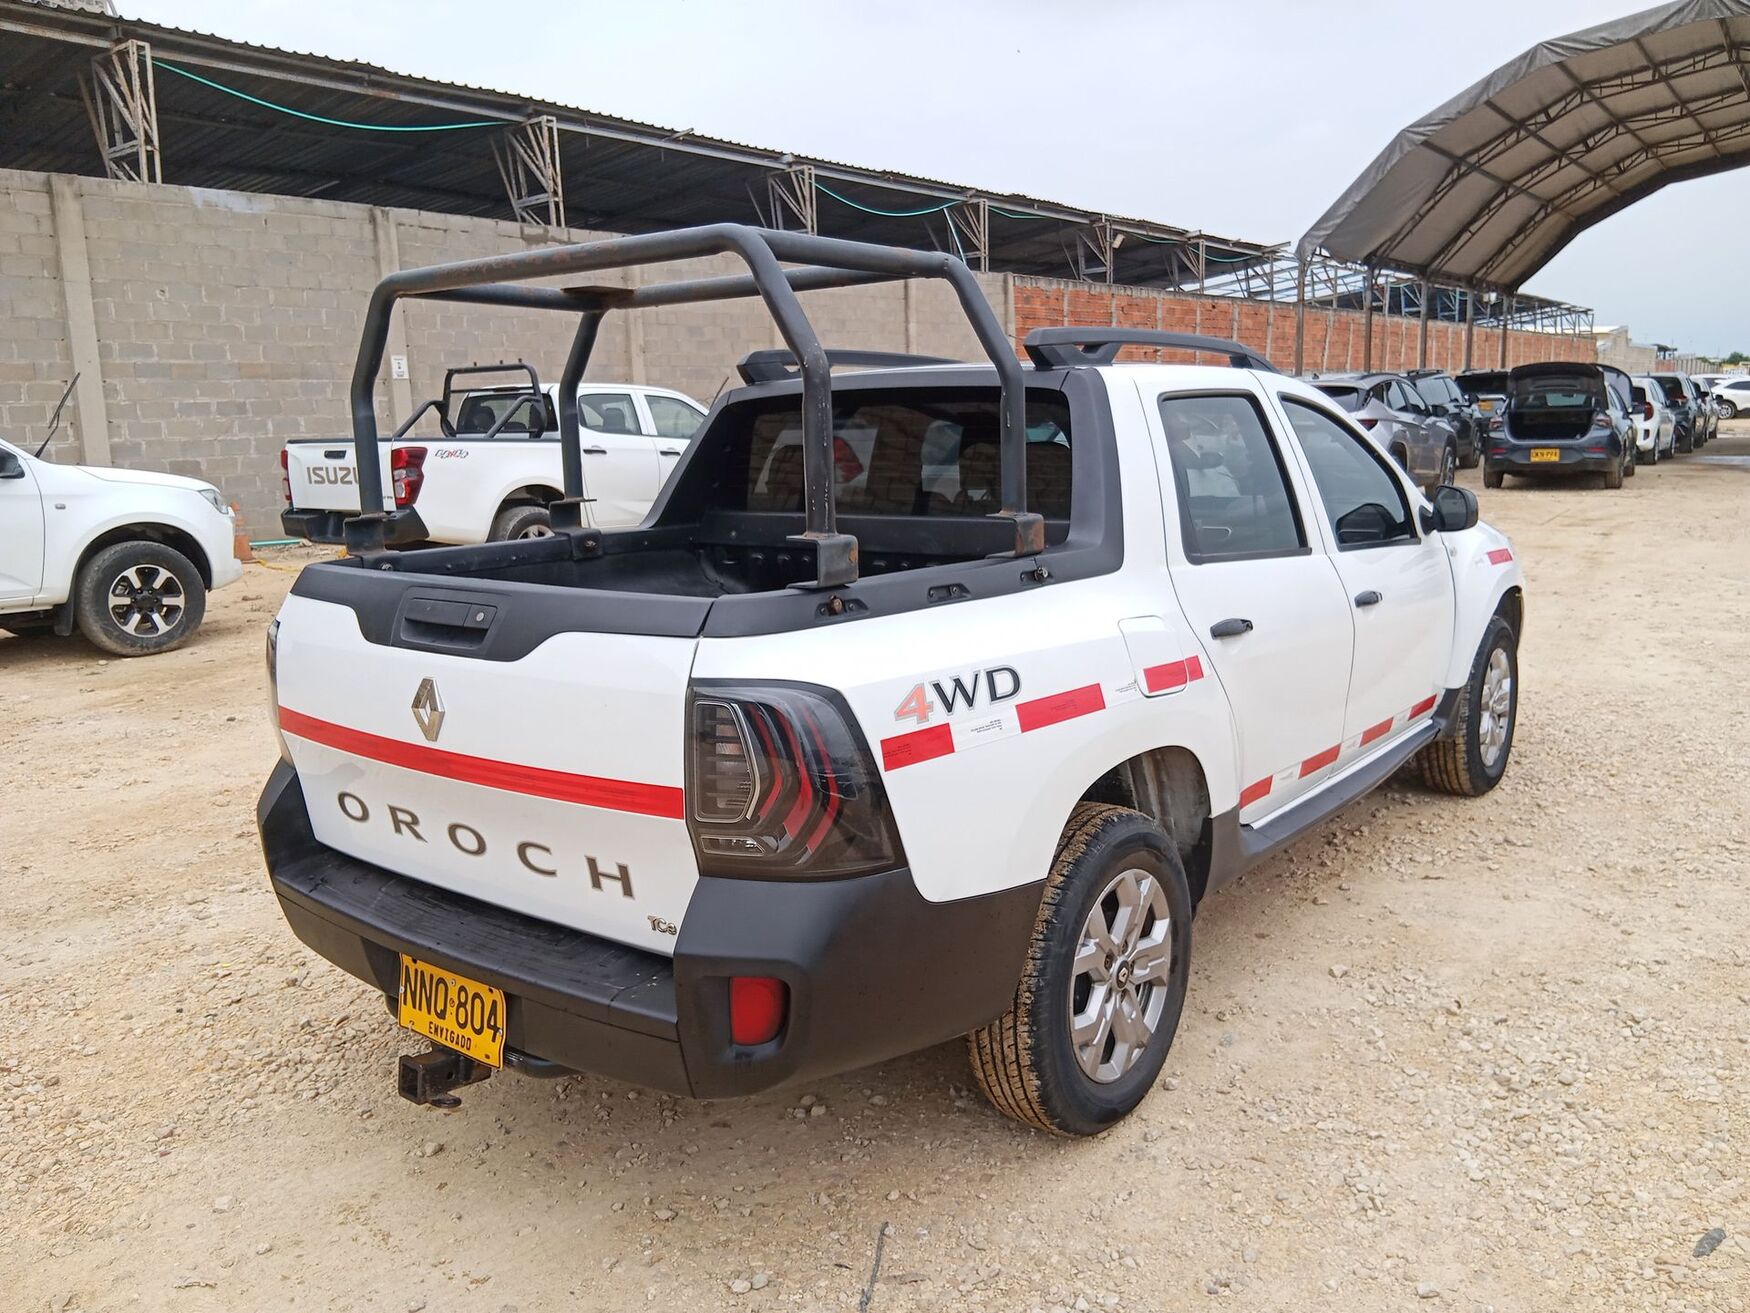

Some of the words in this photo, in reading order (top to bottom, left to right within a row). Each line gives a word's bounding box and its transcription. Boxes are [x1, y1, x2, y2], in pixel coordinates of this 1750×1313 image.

[306, 467, 360, 485] ISUZ
[894, 664, 1022, 724] 4WD
[337, 791, 635, 900] OROCH
[647, 915, 677, 935] TCe
[428, 1021, 472, 1051] ENVIGADO
